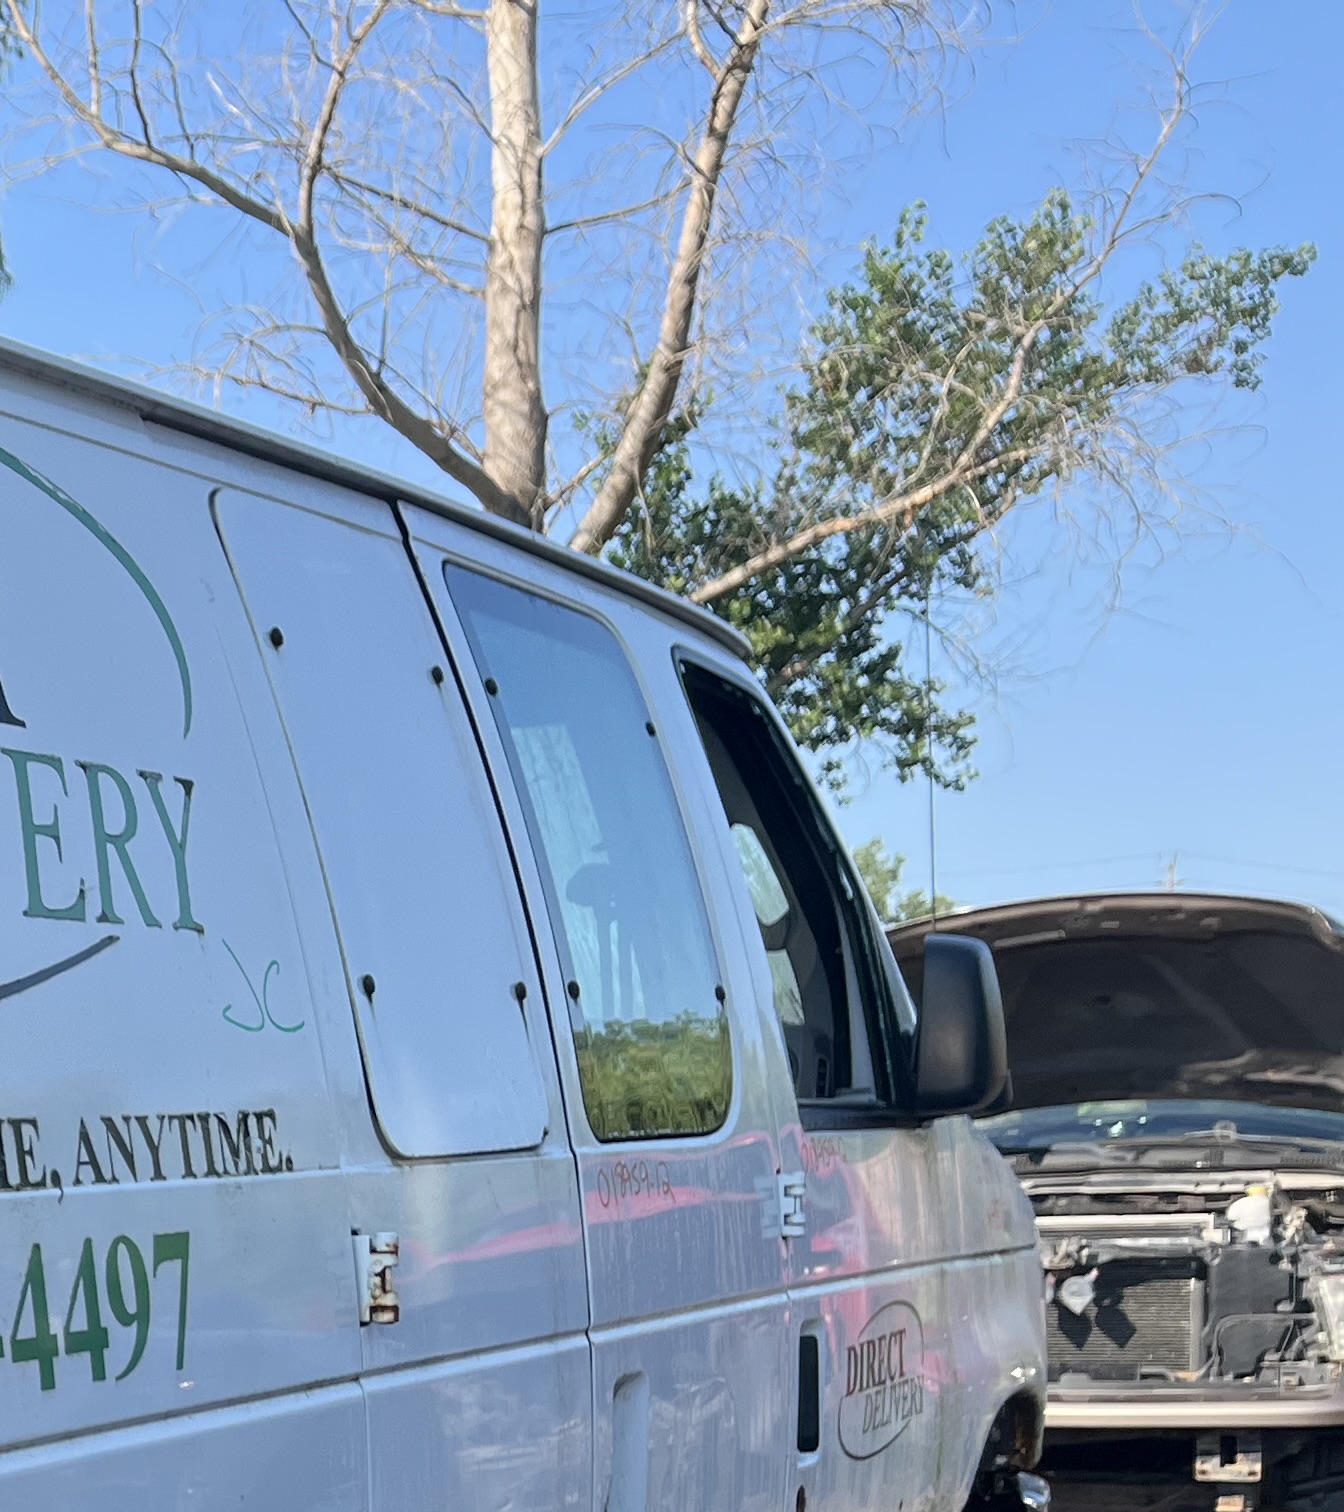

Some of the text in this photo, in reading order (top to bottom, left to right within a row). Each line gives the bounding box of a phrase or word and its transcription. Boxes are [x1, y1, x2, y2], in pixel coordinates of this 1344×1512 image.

[73, 1108, 294, 1185] ANYTIME.
[847, 1328, 906, 1396] DIRECT
[862, 1375, 924, 1434] DELIVERY
